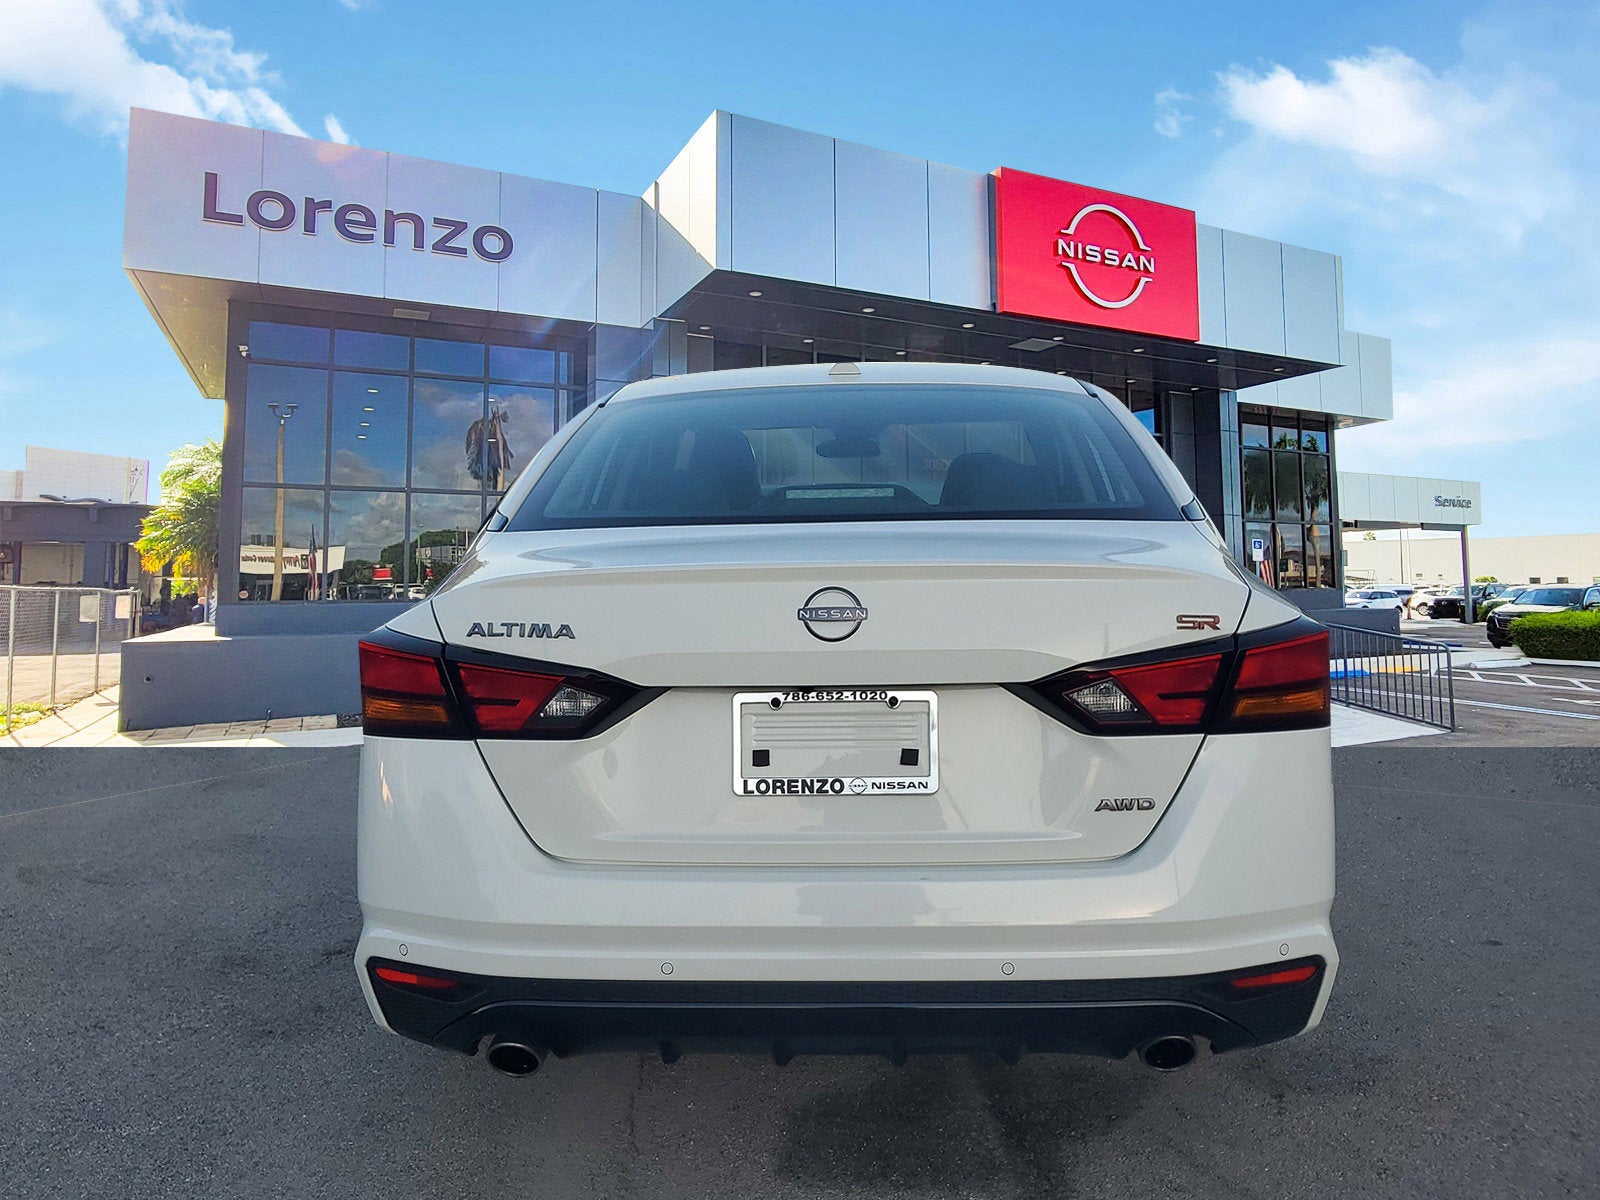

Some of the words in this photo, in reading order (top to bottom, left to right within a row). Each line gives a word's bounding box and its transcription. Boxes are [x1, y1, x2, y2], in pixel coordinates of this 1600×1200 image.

[203, 171, 515, 262] Lorenzo
[1057, 238, 1155, 273] NISSAN
[1434, 495, 1472, 509] Service
[799, 609, 867, 620] NISSAN
[1176, 614, 1221, 631] SR
[466, 622, 576, 639] ALTIMA
[782, 691, 888, 701] 786-652-1020
[743, 778, 845, 795] LORENZO
[871, 781, 929, 790] NISSAN
[1094, 797, 1156, 812] AWD
